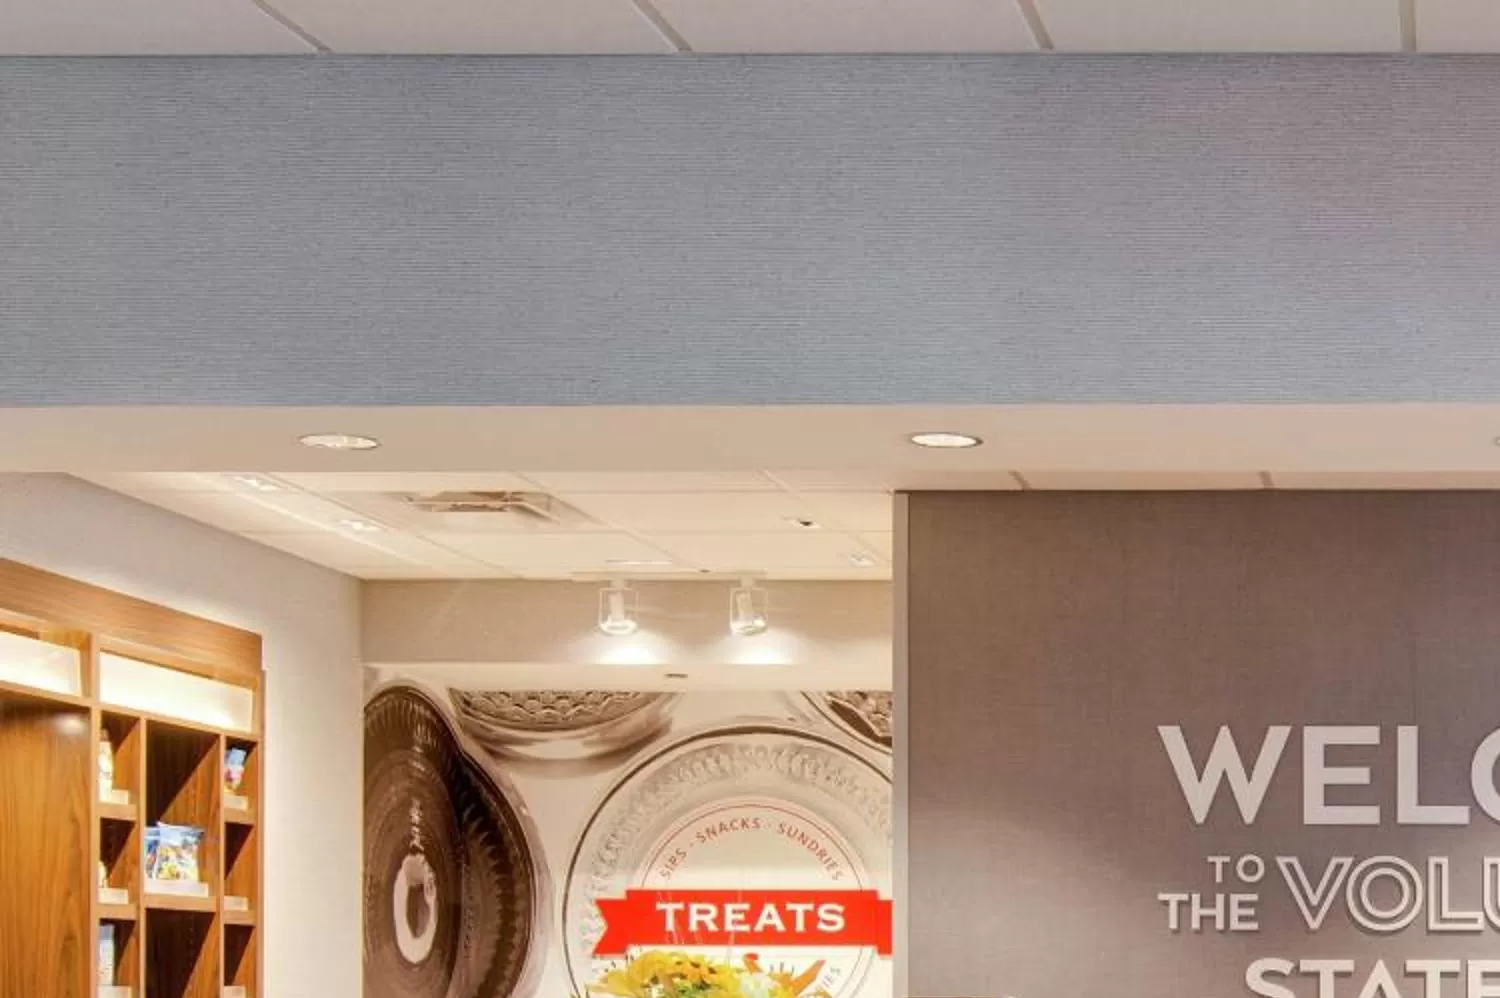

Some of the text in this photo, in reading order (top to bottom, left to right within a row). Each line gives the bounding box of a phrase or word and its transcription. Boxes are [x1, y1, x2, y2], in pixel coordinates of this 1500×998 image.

[660, 816, 843, 880] SIPS SNACKS SUNDRIES
[1207, 854, 1265, 884] TO
[656, 902, 846, 932] TREATS
[1158, 892, 1260, 932] THE
